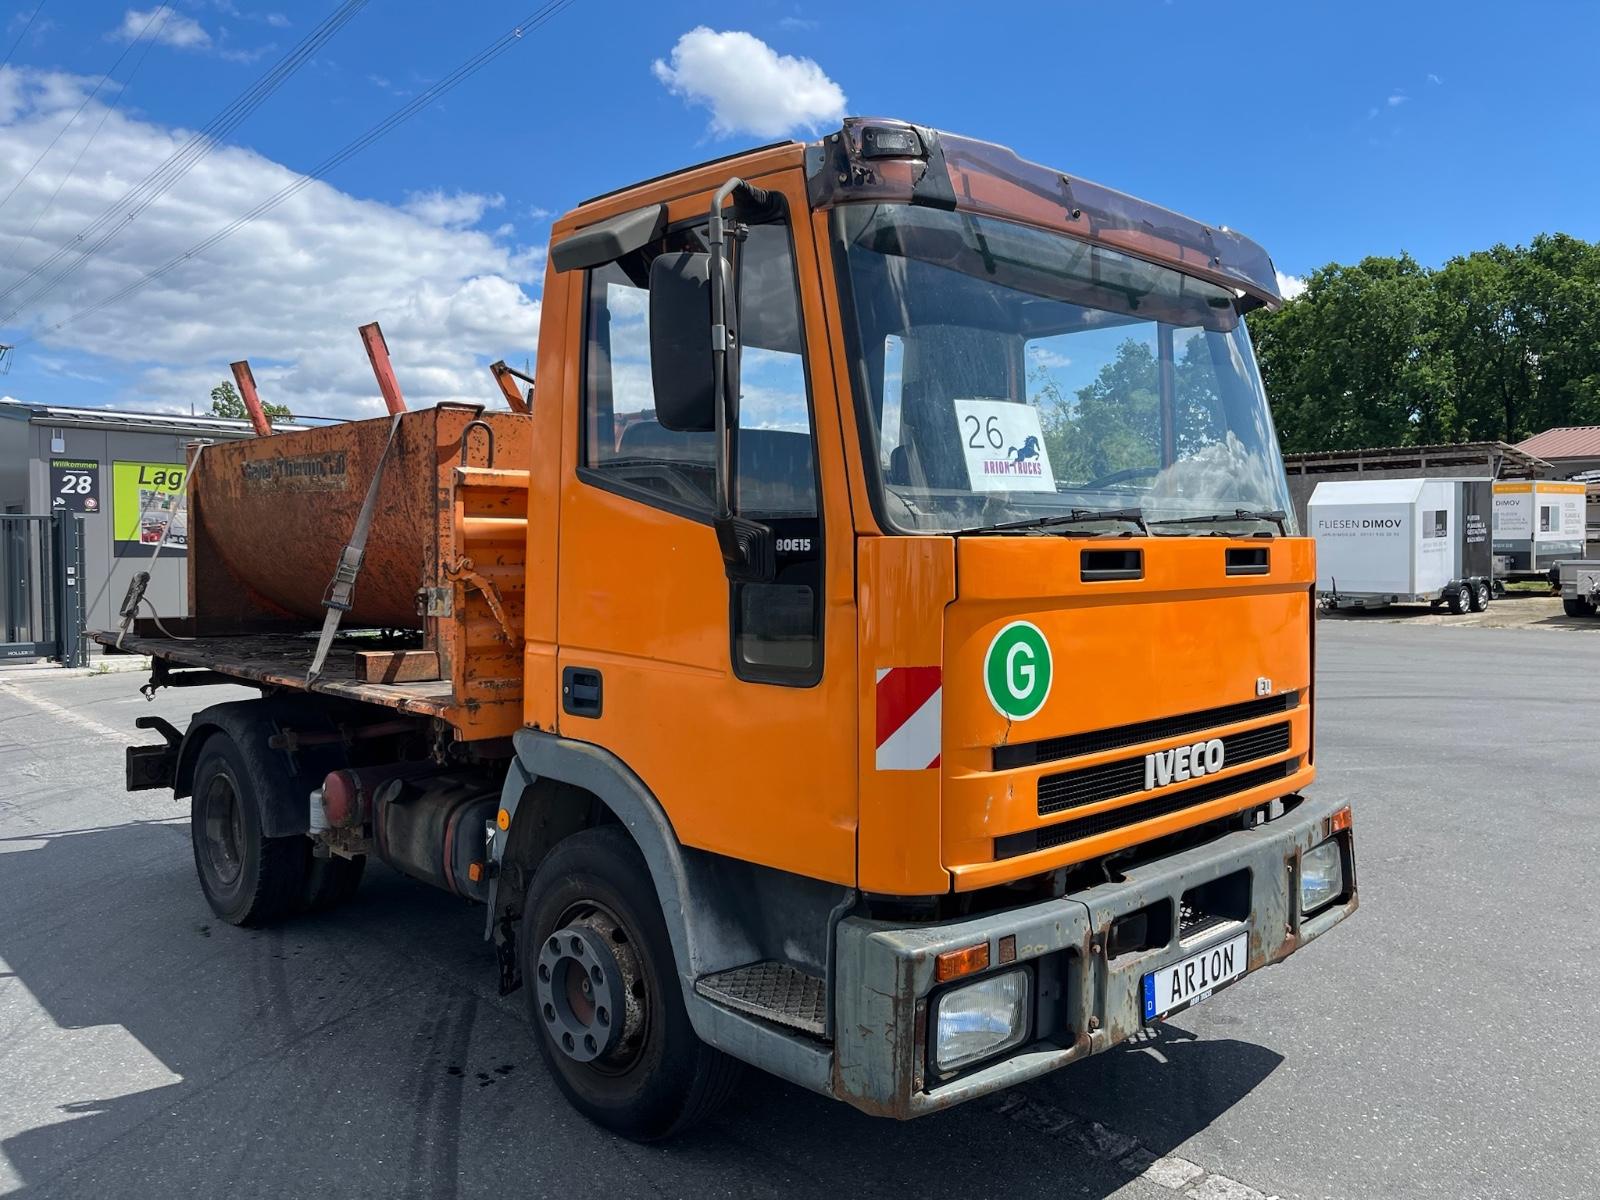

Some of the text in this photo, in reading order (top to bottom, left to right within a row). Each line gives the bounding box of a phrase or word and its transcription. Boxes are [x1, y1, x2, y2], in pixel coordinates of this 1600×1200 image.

[964, 415, 1004, 449] 26
[52, 460, 98, 469] Willkommen
[983, 460, 1042, 475] ARION TRUCKS
[60, 474, 92, 495] 28
[1318, 519, 1402, 529] FLIESEN DIMOV
[775, 538, 811, 552] 80E15
[1006, 641, 1035, 700] G
[1144, 738, 1225, 791] IVECO
[1171, 943, 1234, 1004] ARION
